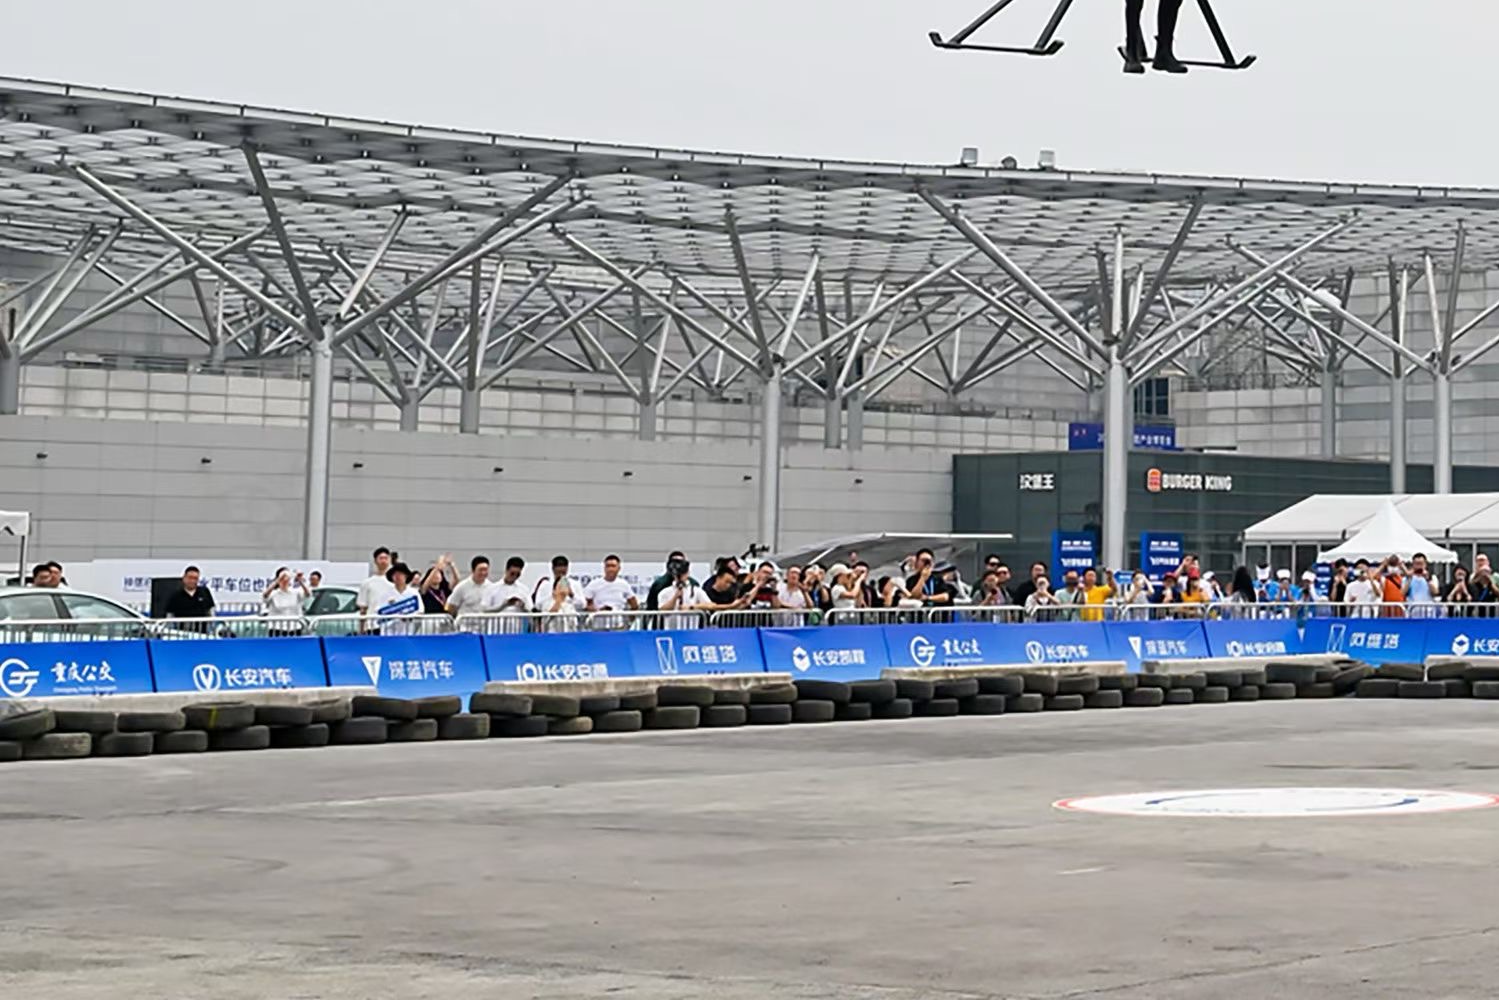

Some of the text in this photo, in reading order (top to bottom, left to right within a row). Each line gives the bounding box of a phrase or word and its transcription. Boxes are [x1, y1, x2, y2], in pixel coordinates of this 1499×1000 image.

[1162, 473, 1232, 491] BURGER KING
[50, 660, 116, 683] 重庆公交
[225, 668, 292, 686] 长安汽车
[389, 660, 454, 681] 深蓝汽车
